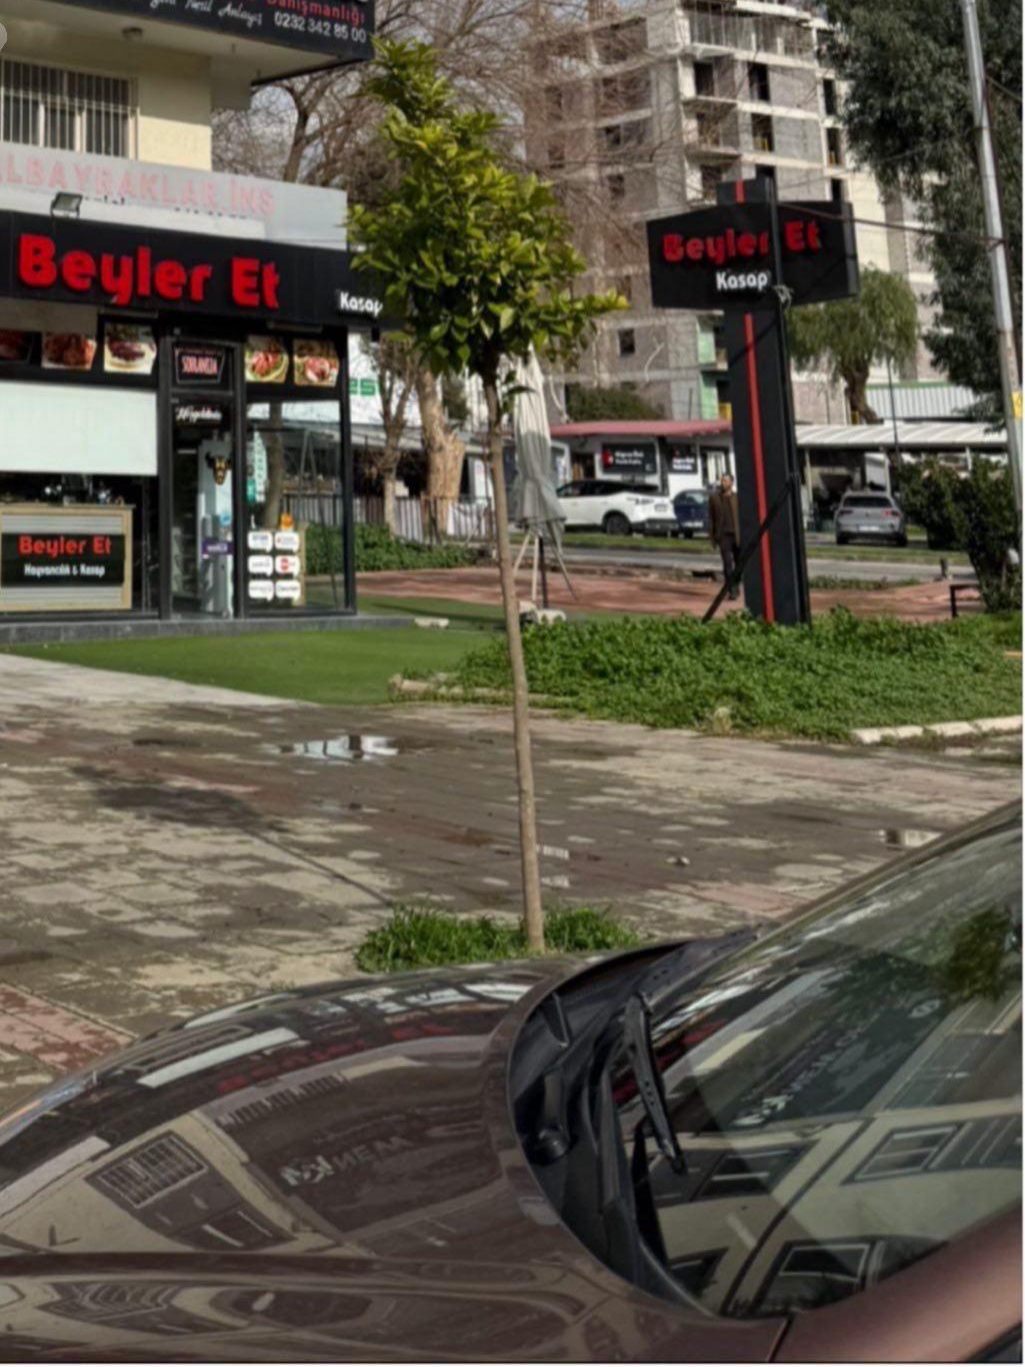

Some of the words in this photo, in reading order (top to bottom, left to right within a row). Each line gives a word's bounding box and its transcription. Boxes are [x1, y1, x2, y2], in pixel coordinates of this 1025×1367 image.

[274, 11, 306, 32] 0232
[307, 19, 331, 37] 342
[351, 27, 367, 43] 00
[661, 227, 771, 265] Beyler
[784, 219, 822, 252] Et
[17, 233, 213, 307] Beyler
[231, 256, 281, 309] Et
[716, 270, 769, 292] Kasap
[18, 534, 87, 559] Beyler
[92, 535, 112, 555] Et
